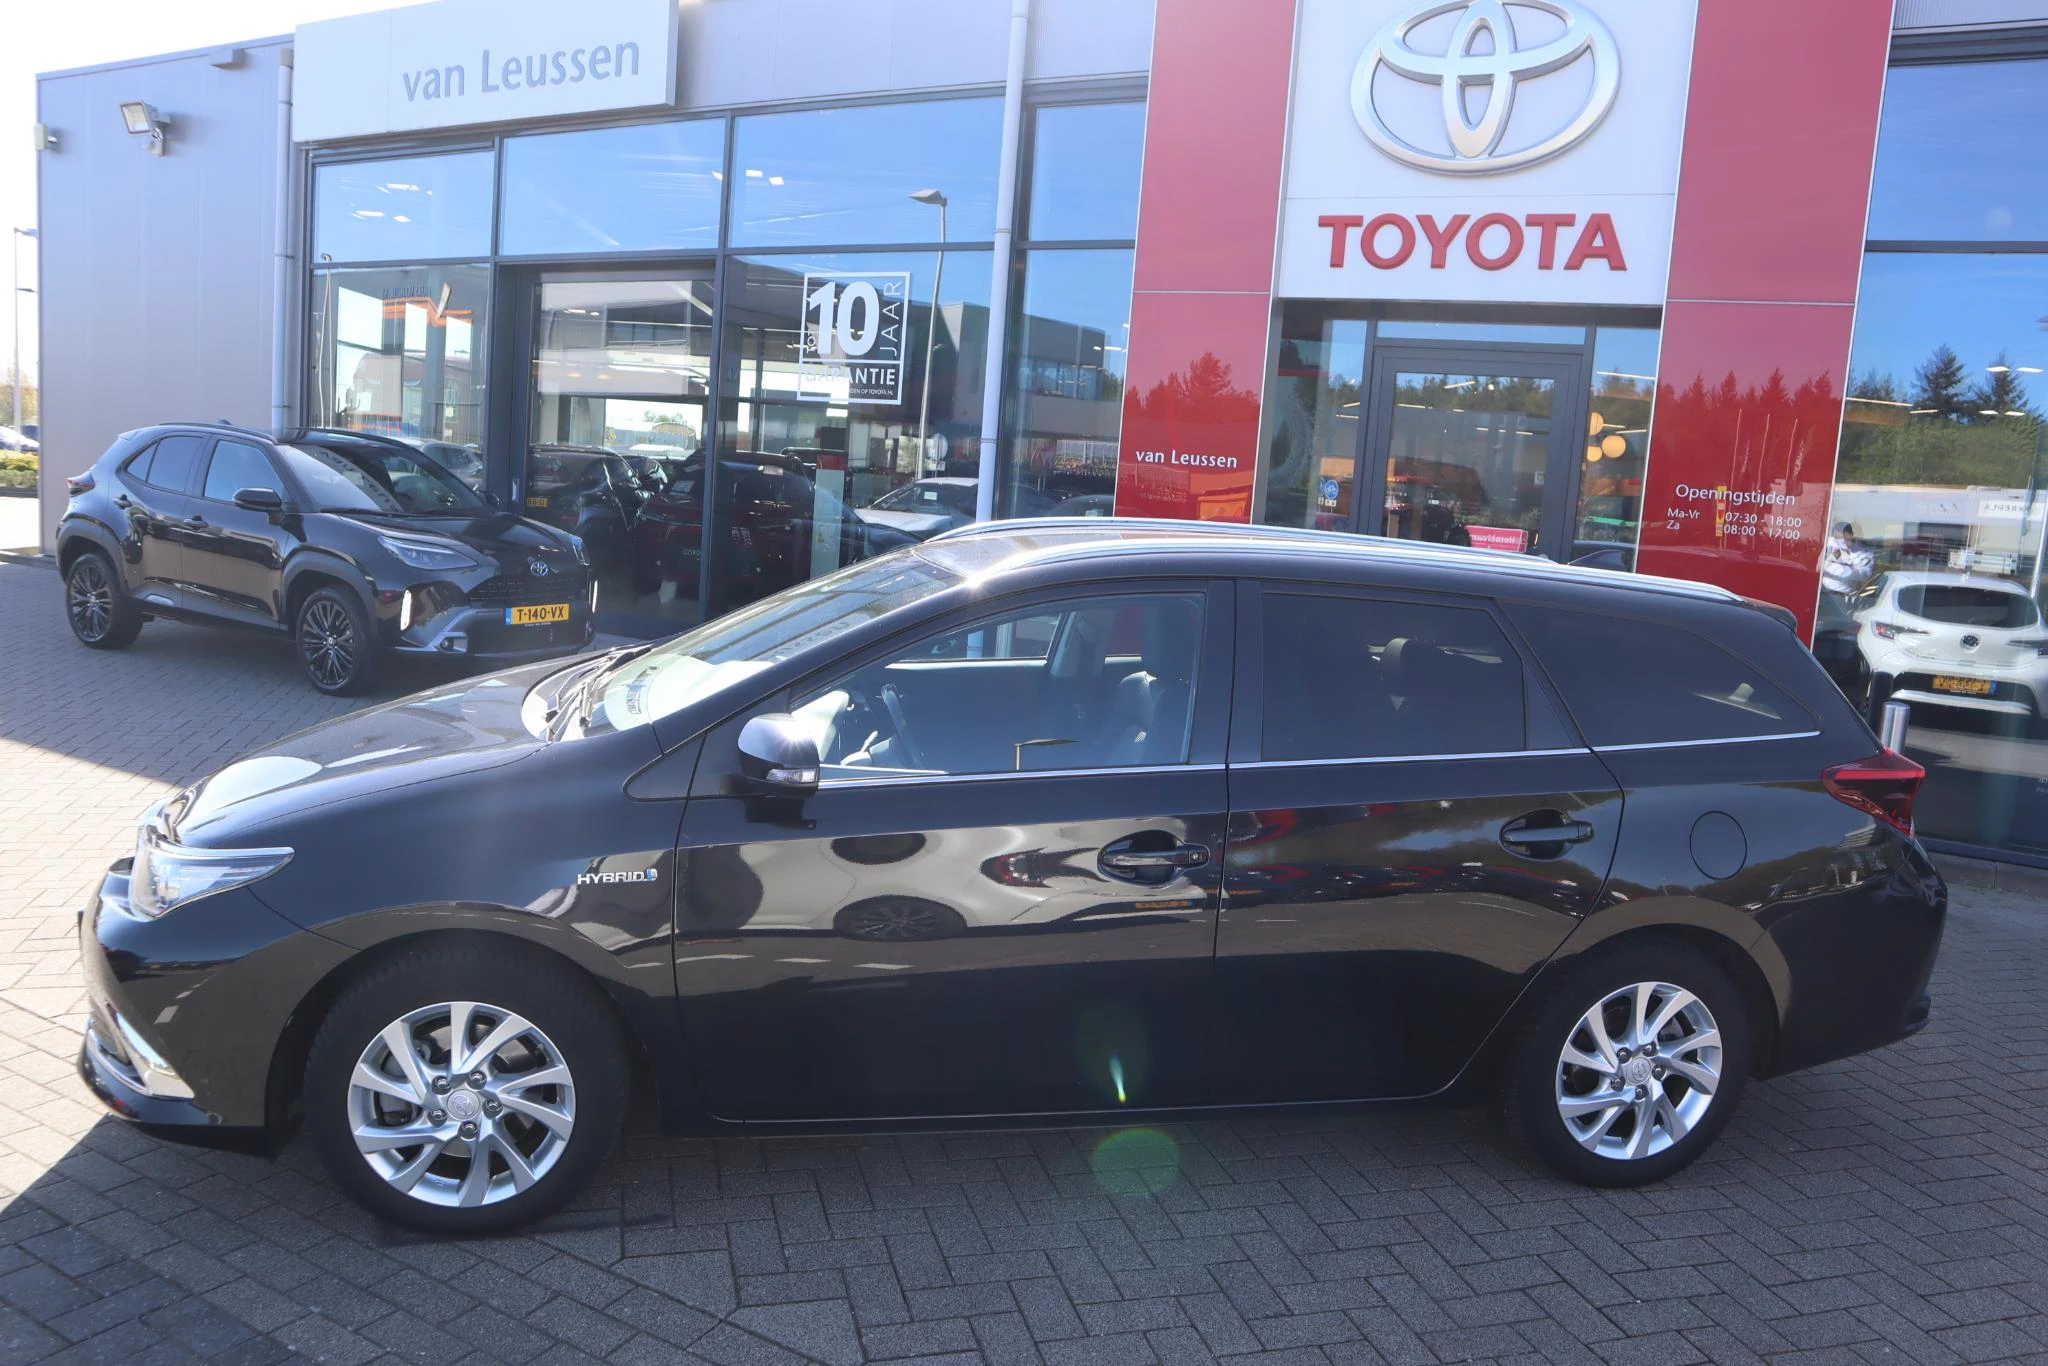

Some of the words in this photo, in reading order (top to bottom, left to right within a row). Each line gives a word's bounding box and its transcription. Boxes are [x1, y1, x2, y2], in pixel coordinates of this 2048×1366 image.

[402, 64, 465, 102] van
[481, 41, 640, 93] Leussen
[1318, 212, 1627, 271] TOYOTA
[809, 281, 880, 356] 10
[880, 281, 902, 357] JAAR
[1136, 451, 1165, 464] van
[1171, 449, 1238, 469] Leussen
[1675, 484, 1795, 507] Openingstijden
[1667, 508, 1700, 520] Ma-Vr
[1725, 512, 1758, 524] 07:30
[1770, 515, 1802, 528] 18:00
[1666, 520, 1680, 530] Za
[1723, 525, 1756, 536] 08:00
[1768, 528, 1800, 540] 17:00
[517, 606, 564, 622] T-140-VX
[577, 871, 645, 884] HYBRID
